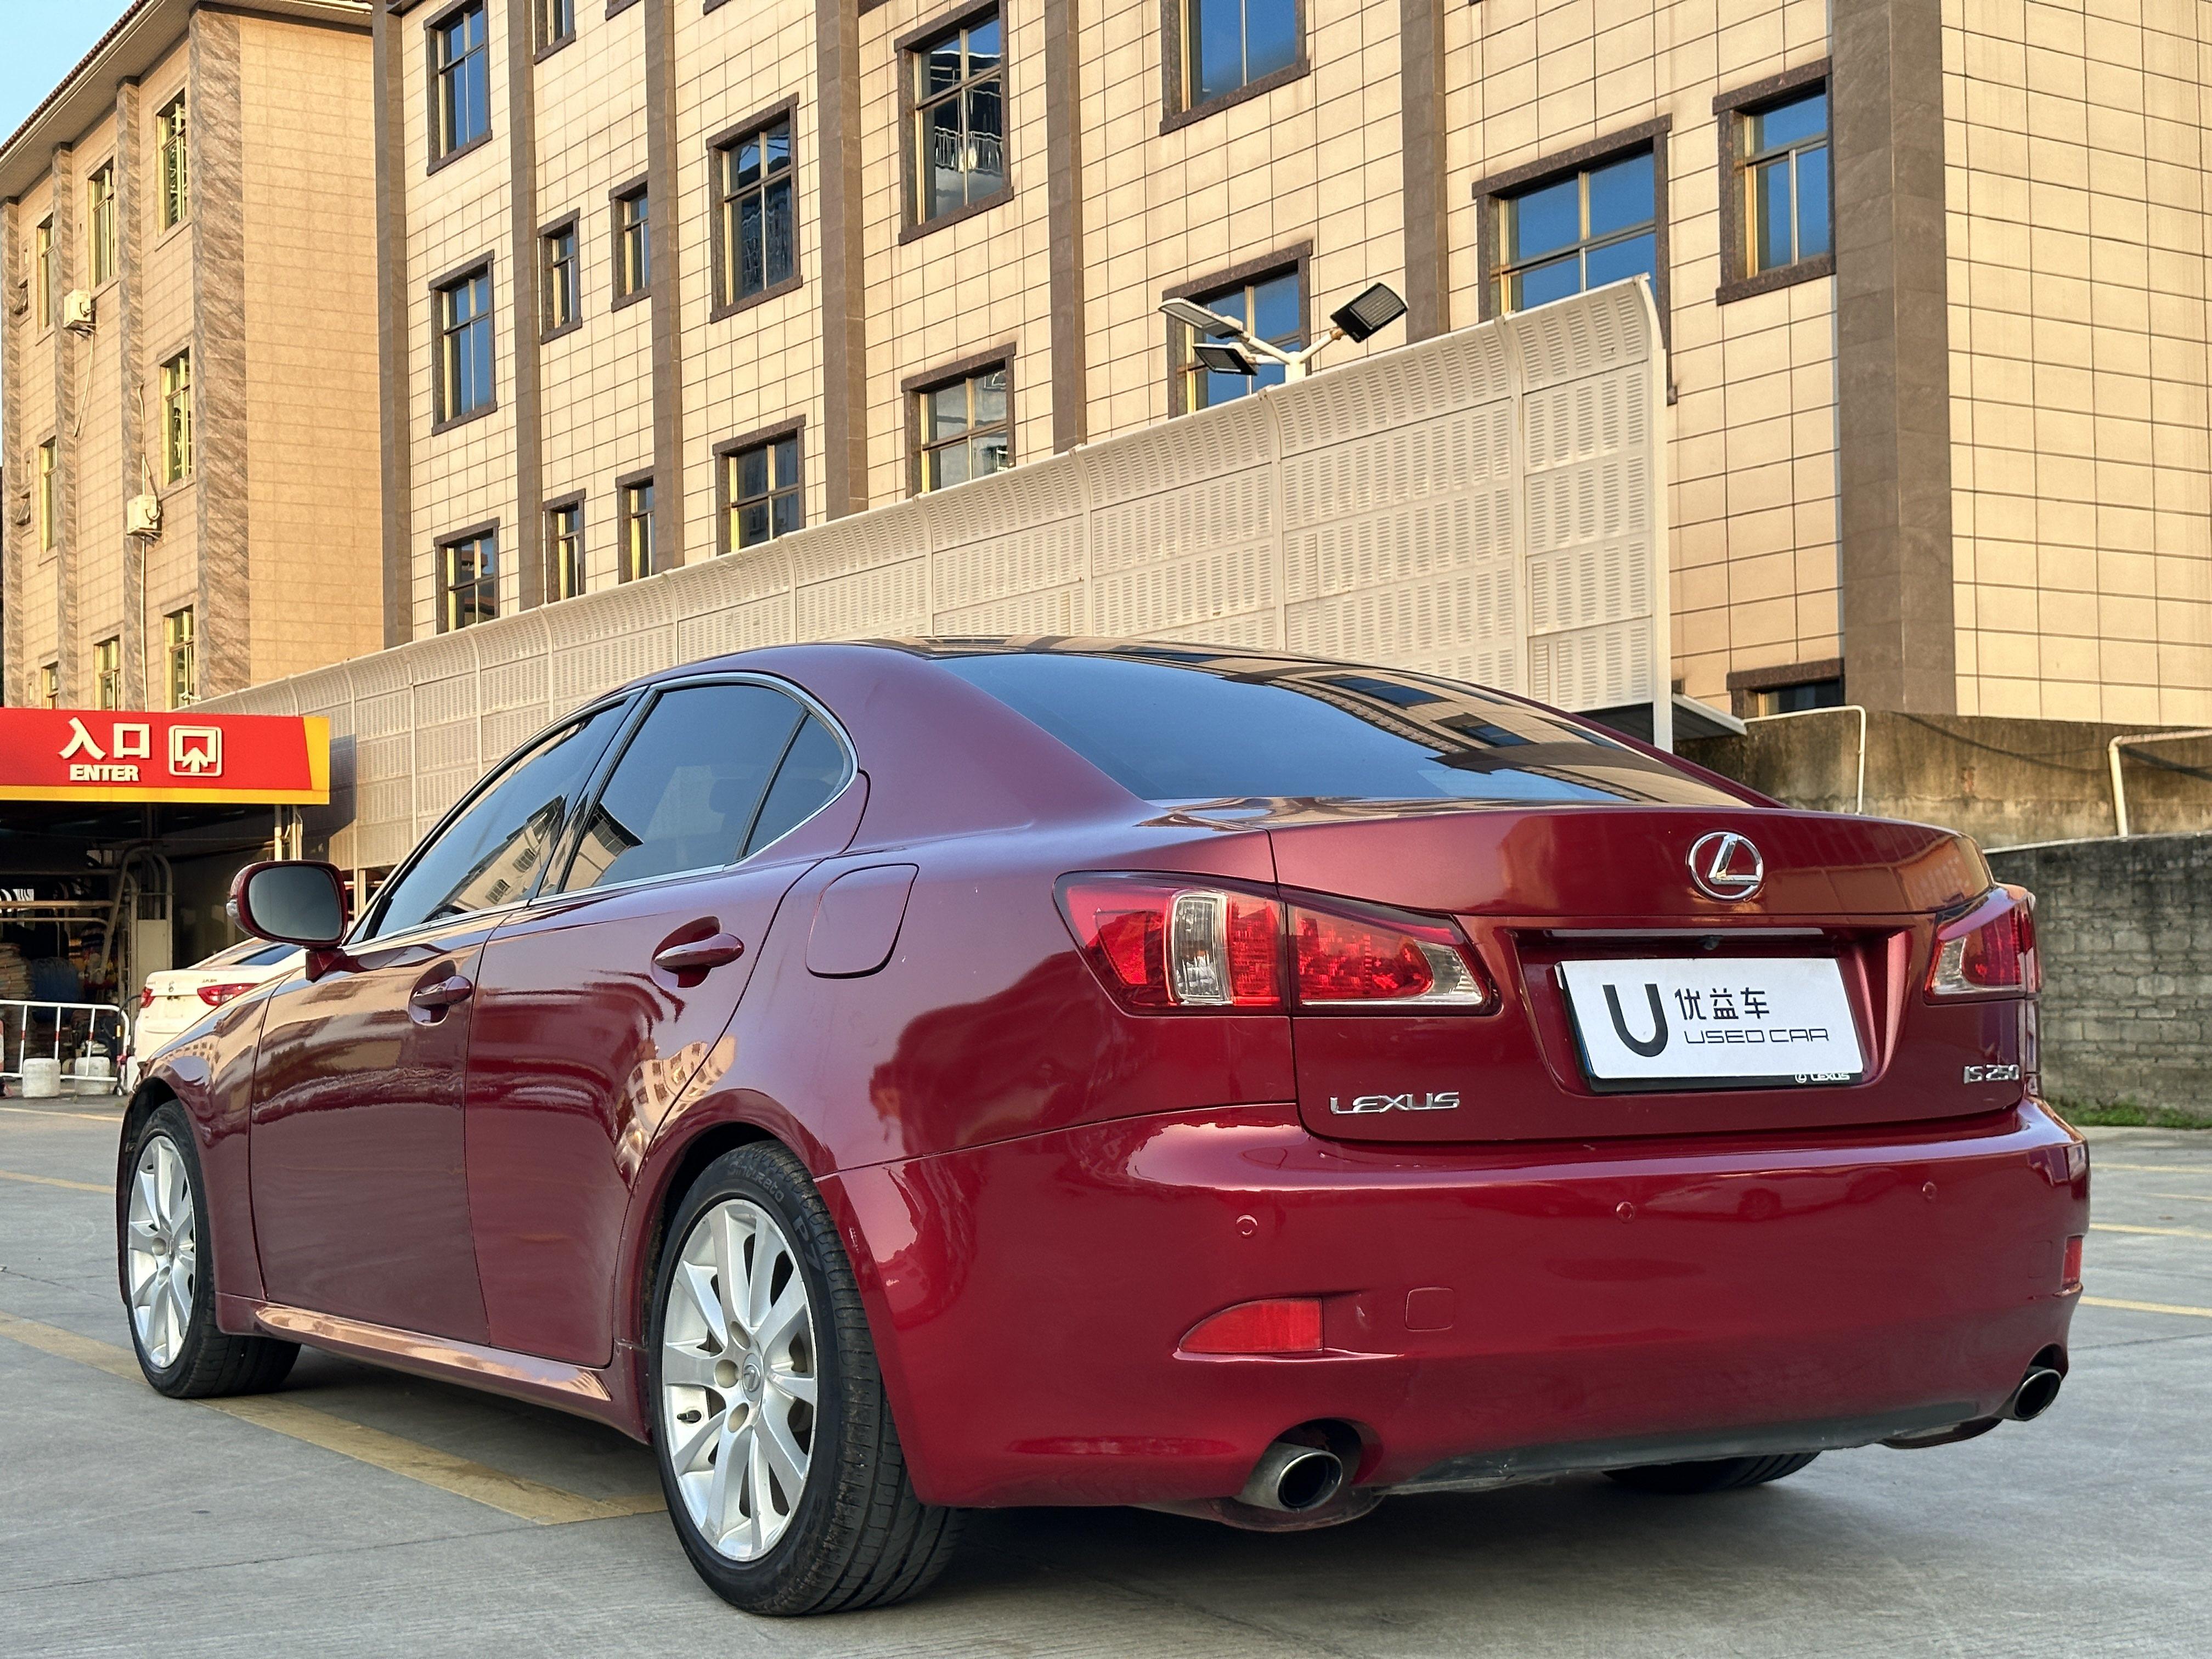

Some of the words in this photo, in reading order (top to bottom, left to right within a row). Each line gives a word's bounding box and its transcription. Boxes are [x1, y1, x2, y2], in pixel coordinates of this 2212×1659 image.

[58, 716, 150, 760] 入口
[70, 764, 139, 781] ENTER
[1674, 987, 1770, 1020] 优益车
[1602, 983, 1668, 1058] U
[1684, 1029, 1765, 1045] USED
[1769, 1028, 1830, 1042] CAR
[1963, 1066, 1983, 1084] IS
[1985, 1064, 2019, 1081] 250
[1330, 1091, 1459, 1114] LEXUS
